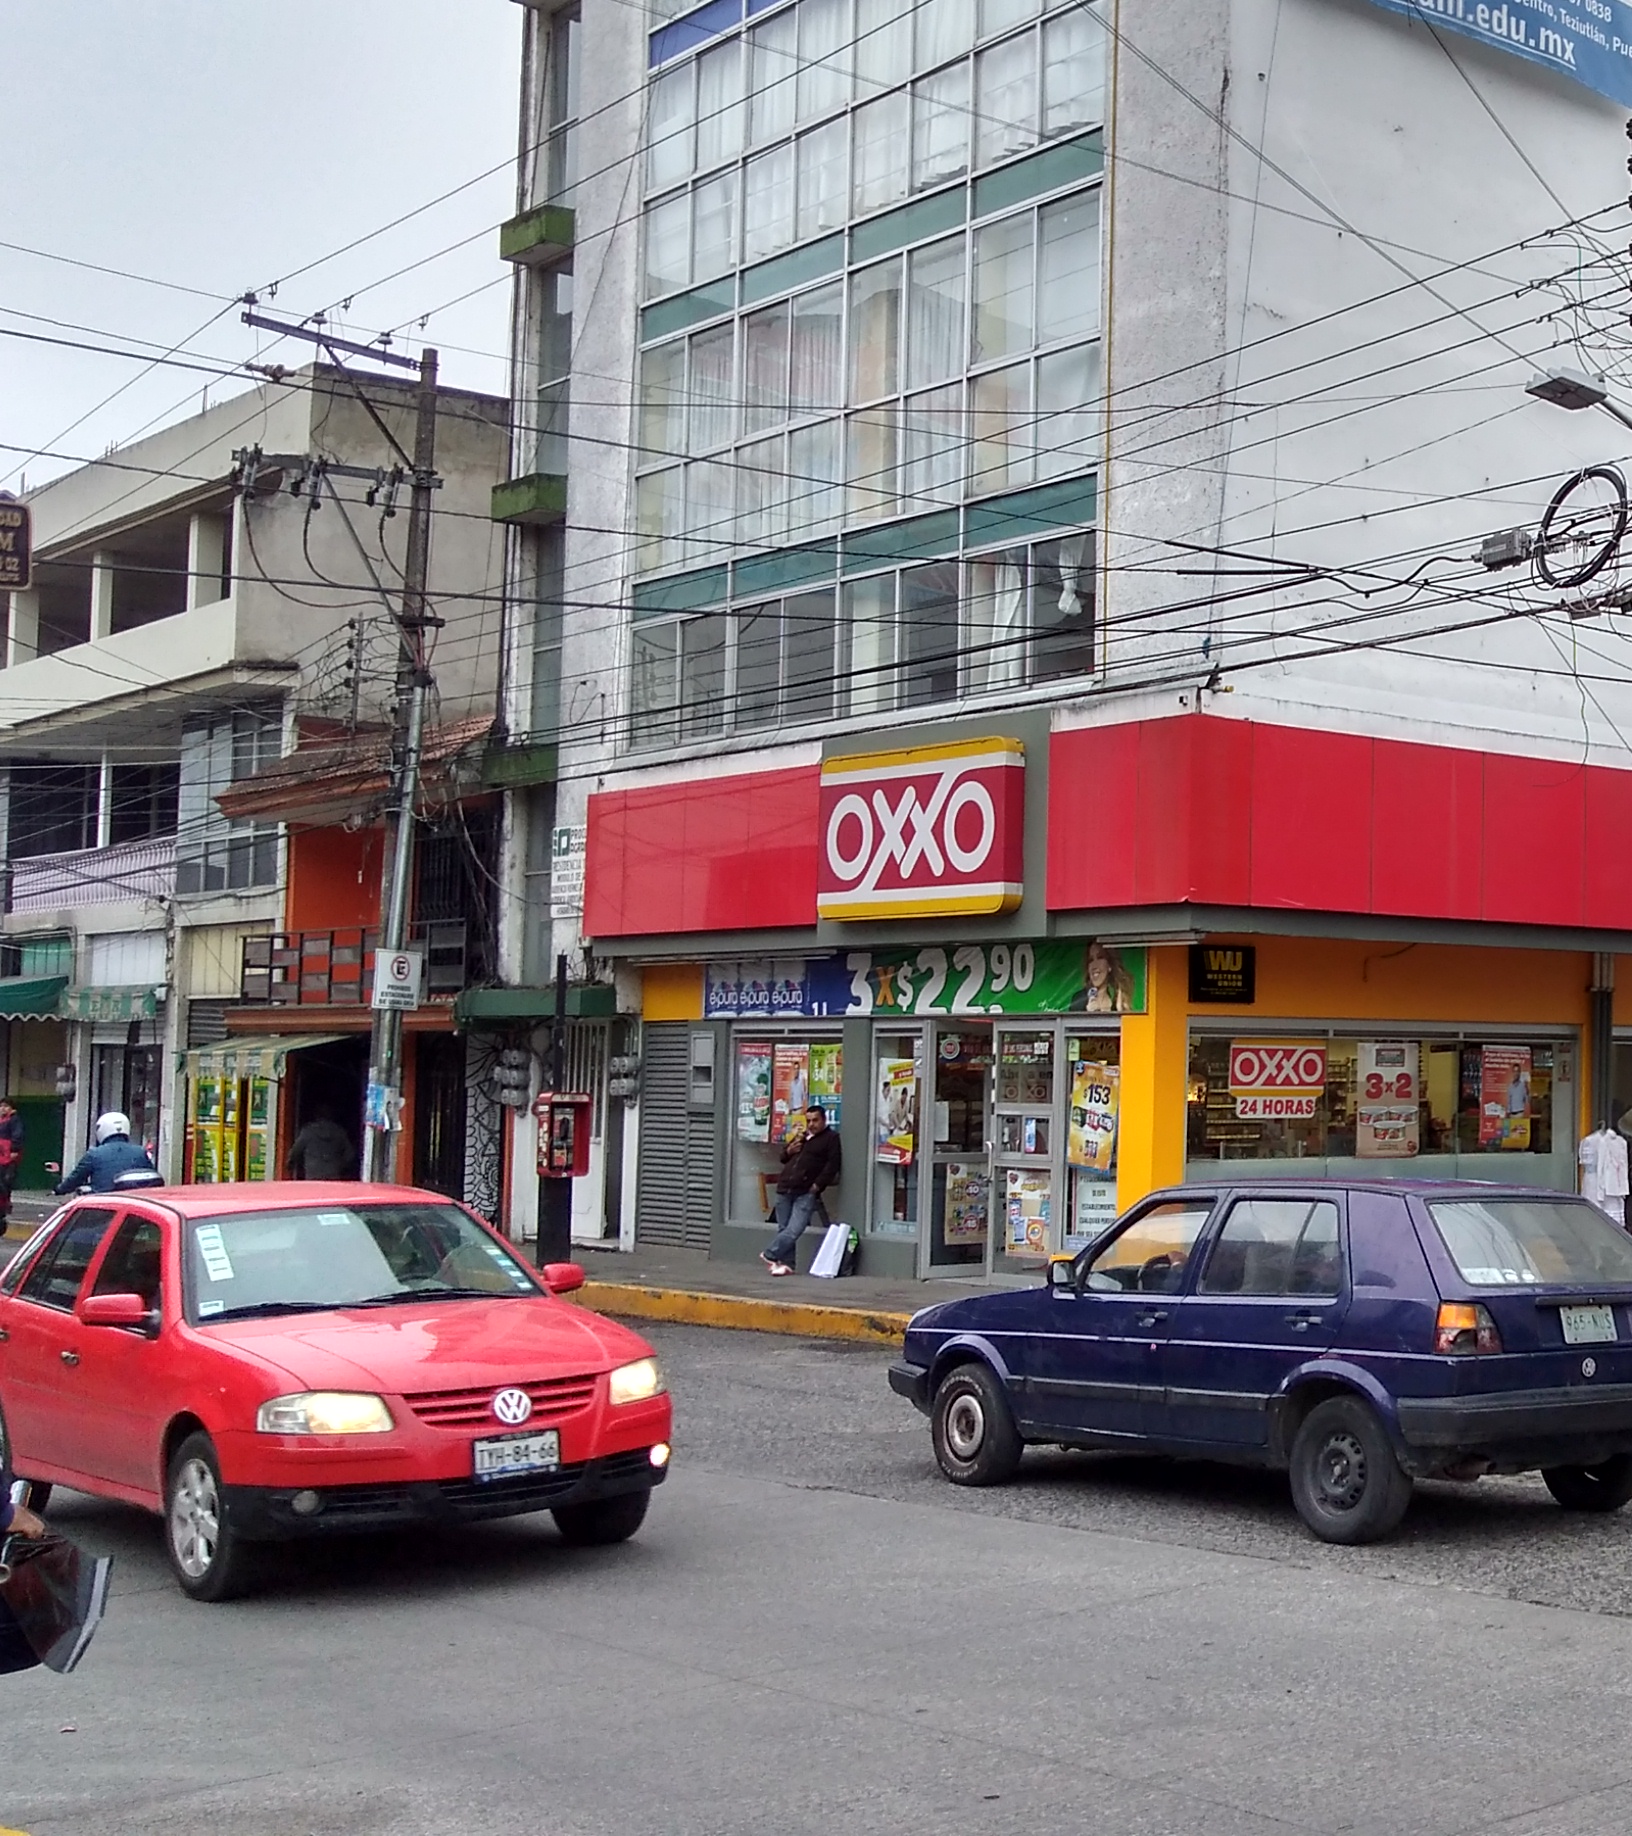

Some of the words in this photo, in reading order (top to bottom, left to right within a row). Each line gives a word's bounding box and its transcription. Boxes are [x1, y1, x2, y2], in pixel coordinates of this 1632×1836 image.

[1585, 0, 1612, 23] 0838
[1560, 8, 1611, 50] Teziutlán,
[827, 774, 995, 889] OXXO
[1203, 950, 1243, 971] WU
[846, 953, 874, 1015] 3
[1234, 1049, 1323, 1087] OXXO
[1239, 1099, 1258, 1115] 24
[1263, 1099, 1315, 1115] HORAS
[1566, 1313, 1613, 1331] 965-NUS
[478, 1441, 557, 1467] TYH-84-66
